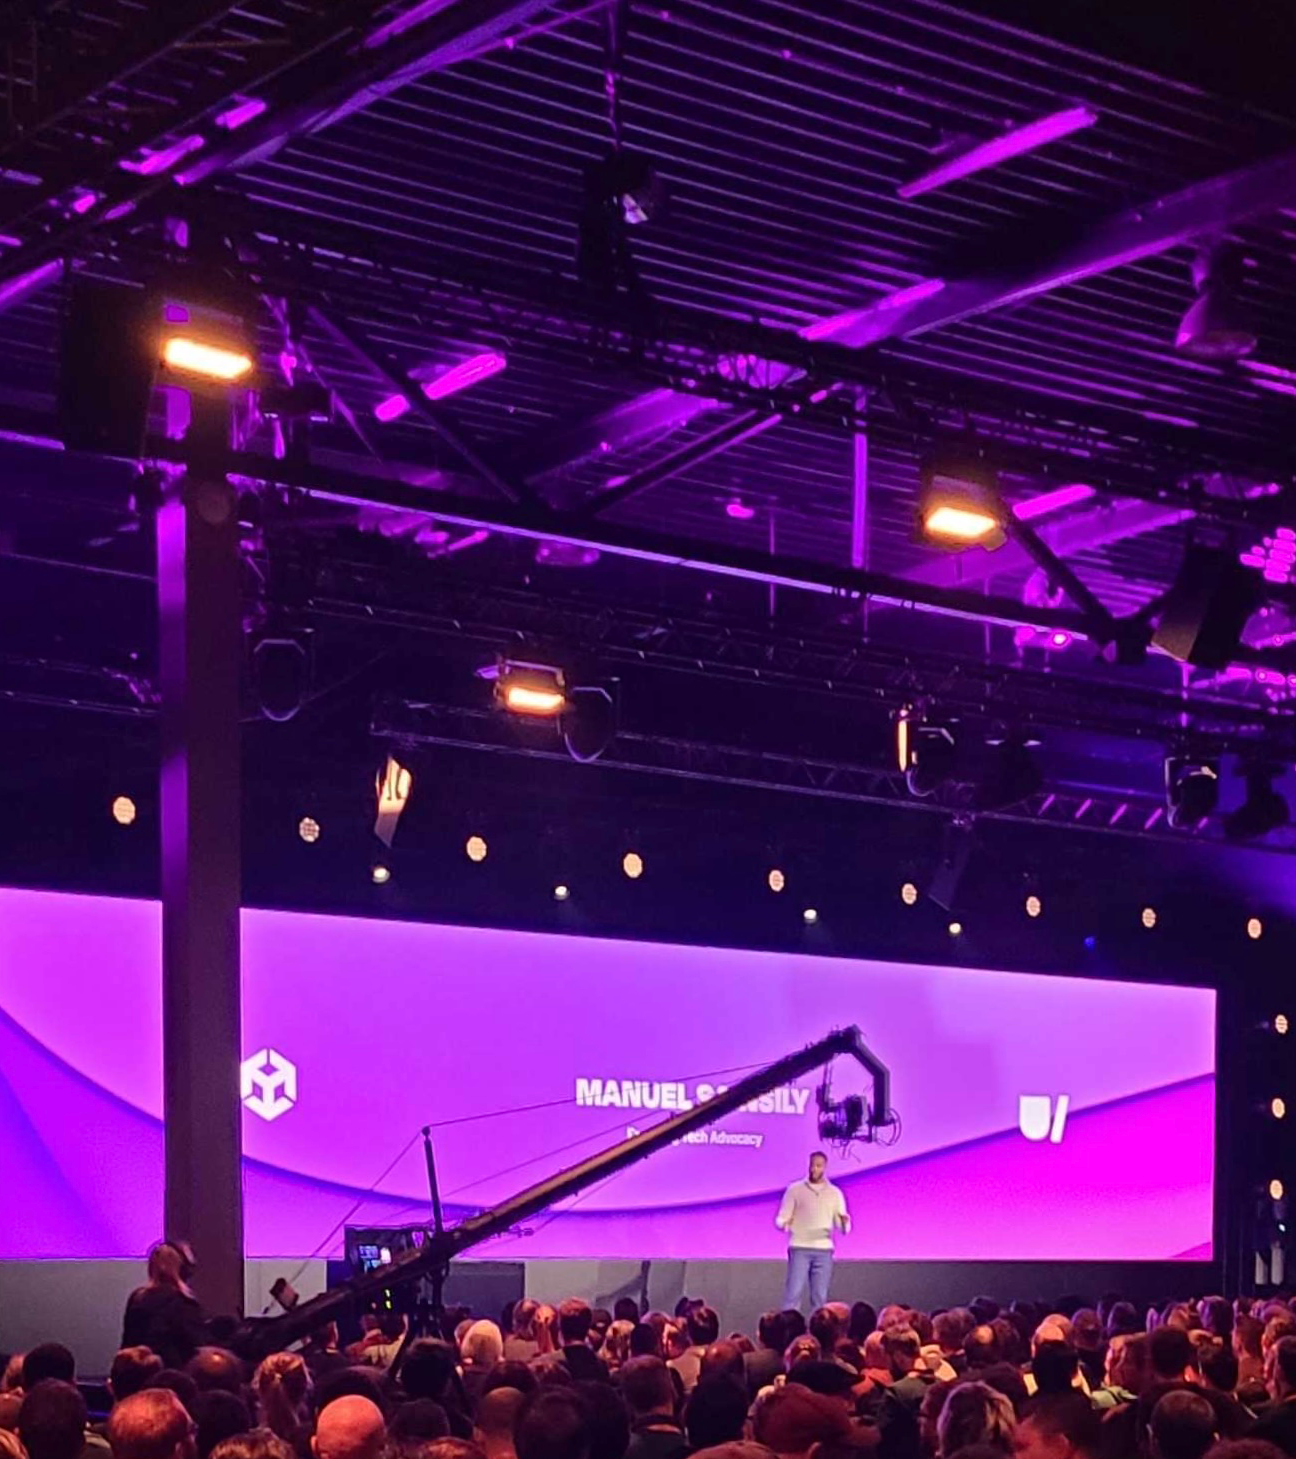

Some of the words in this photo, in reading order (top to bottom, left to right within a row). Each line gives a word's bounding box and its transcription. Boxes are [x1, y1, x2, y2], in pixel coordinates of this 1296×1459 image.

[575, 1078, 694, 1111] MANUEL
[695, 1083, 810, 1115] SSILY
[710, 1131, 764, 1148] Advocacy
